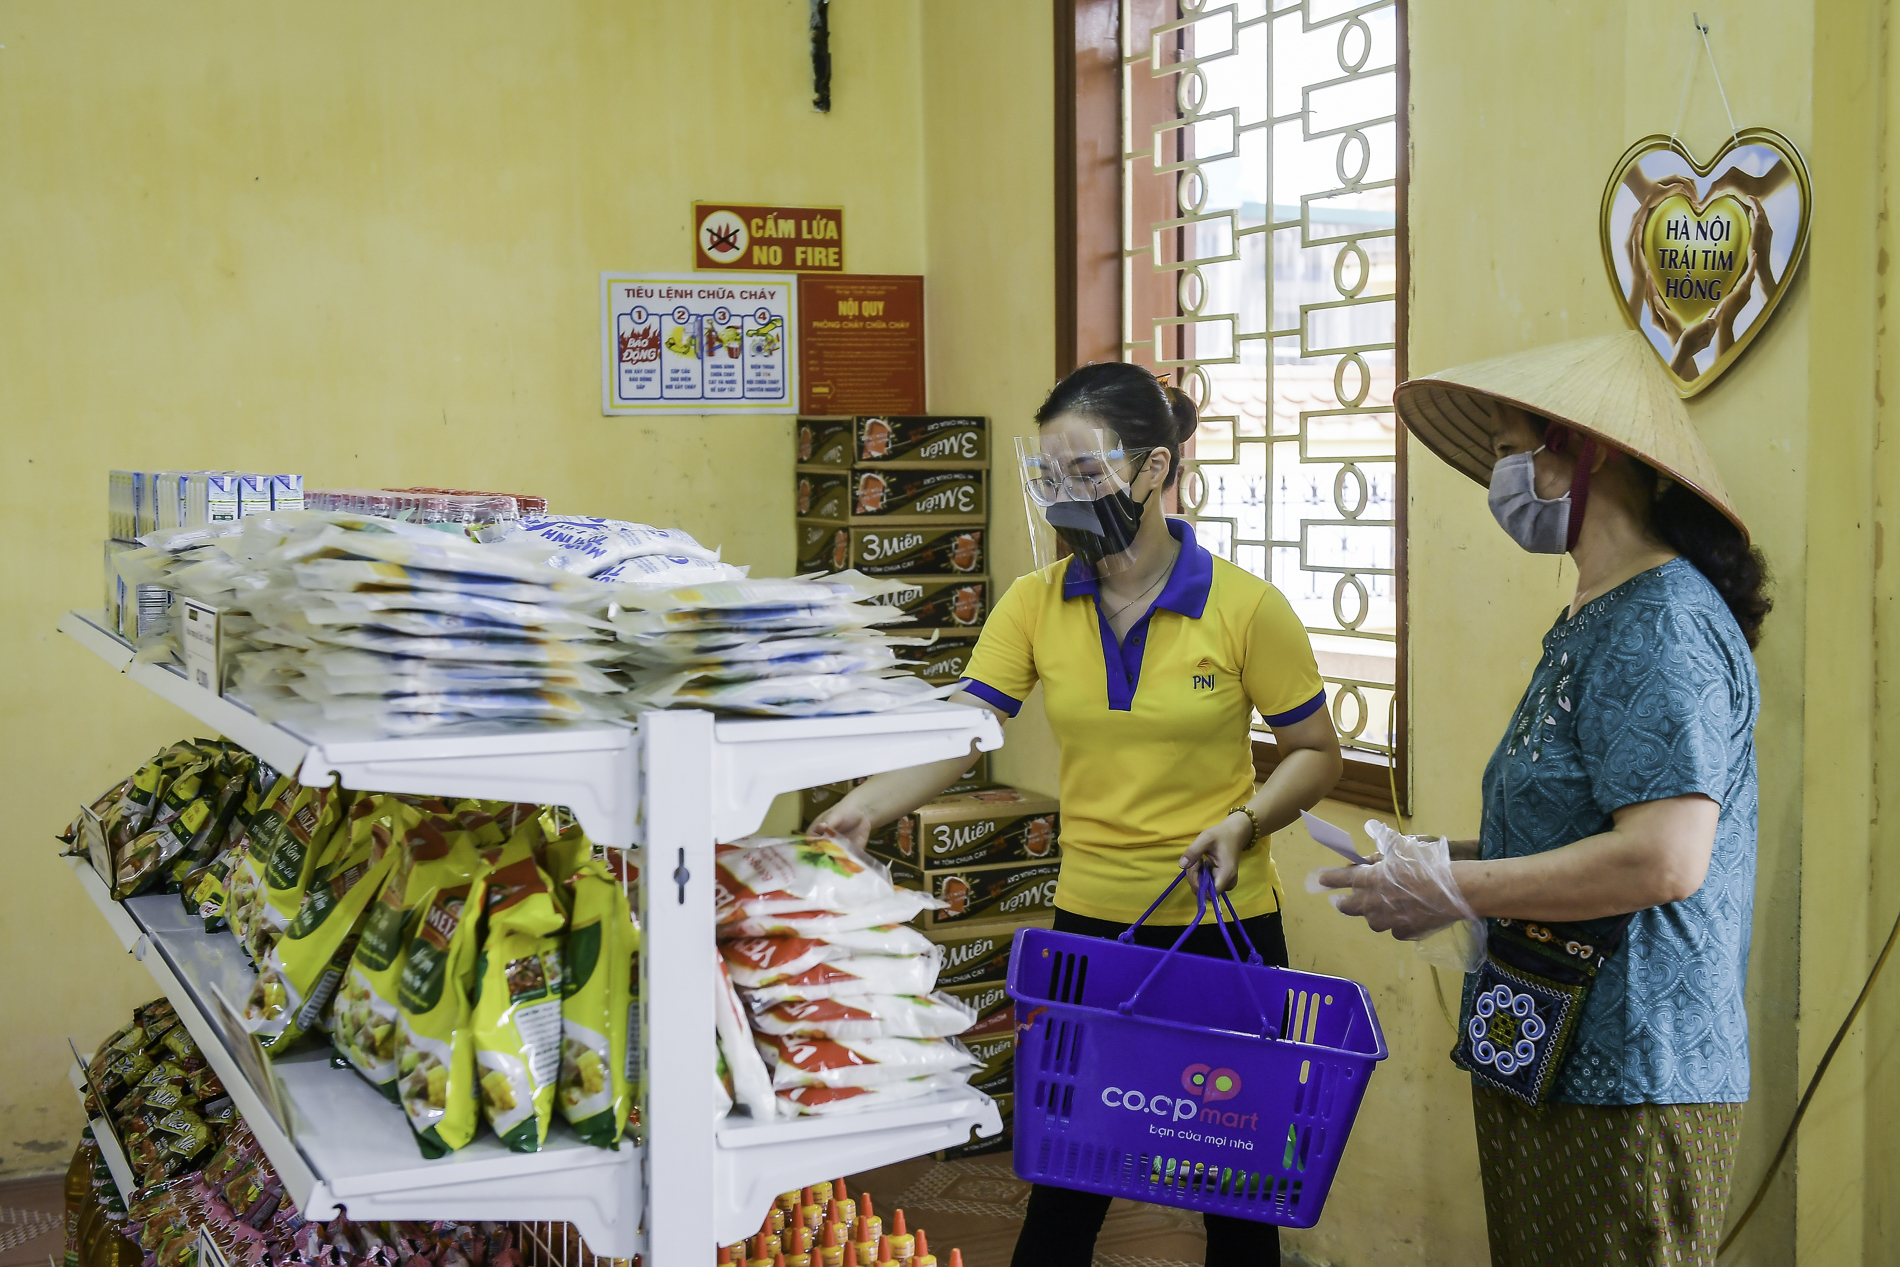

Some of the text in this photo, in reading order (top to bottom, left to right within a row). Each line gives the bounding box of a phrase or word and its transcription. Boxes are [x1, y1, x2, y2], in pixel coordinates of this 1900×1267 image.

[751, 212, 796, 238] CẤM
[1666, 215, 1730, 247] HÀ NỘI
[752, 246, 840, 267] NO FIRE
[1659, 244, 1734, 272] TRÁI TIM
[625, 286, 776, 302] TIÊU LỆNH CHỮA CHÁY
[1666, 270, 1722, 301] HỒNG
[636, 310, 642, 320] 1
[676, 310, 686, 320] 2
[717, 311, 727, 320] 3
[758, 312, 767, 320] 4
[862, 300, 885, 318] QUY
[1192, 674, 1215, 691] PNJ
[1149, 1124, 1254, 1151] bạn của mọi nhà
